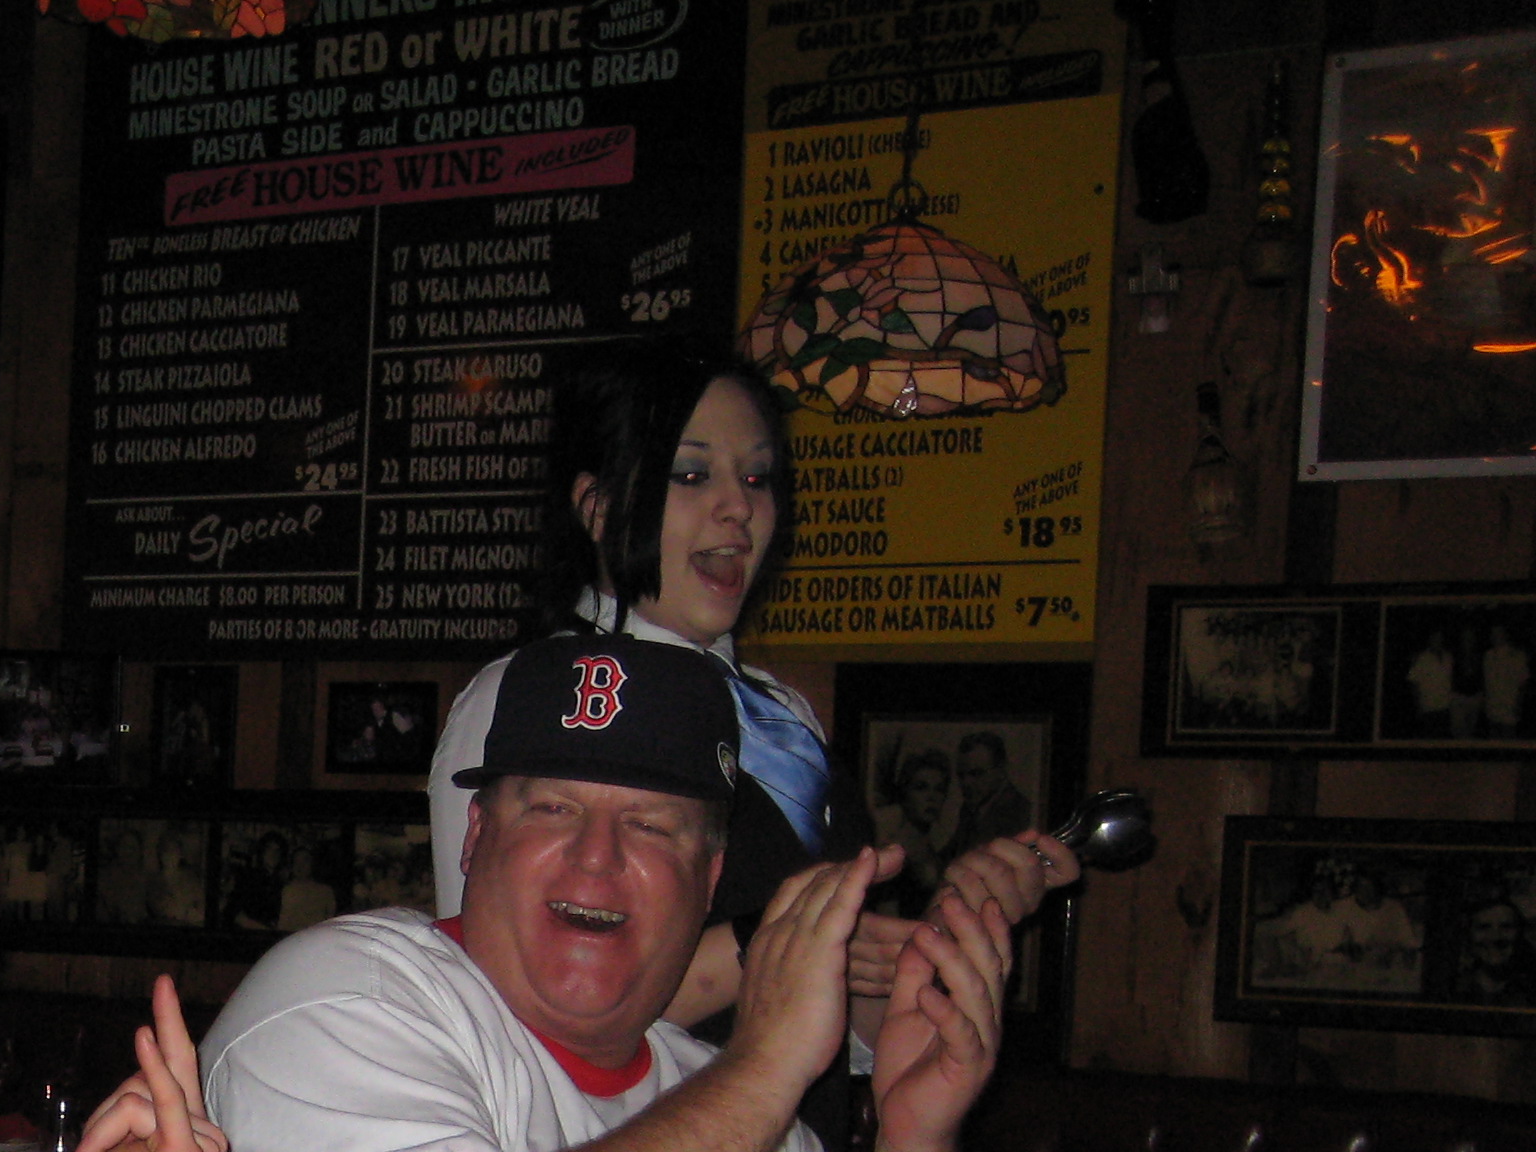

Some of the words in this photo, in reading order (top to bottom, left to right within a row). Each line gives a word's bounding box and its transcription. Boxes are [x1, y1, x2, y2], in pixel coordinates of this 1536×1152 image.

[598, 9, 664, 39] DINNER
[129, 55, 214, 104] HOUSE
[223, 43, 299, 92] WINE
[315, 30, 389, 80] RED
[400, 30, 443, 68] or
[453, 6, 584, 63] WHITE
[128, 95, 279, 140] MINESTRONE
[286, 86, 347, 121] SOUP
[352, 92, 375, 114] OR
[380, 74, 458, 112] SALAD
[486, 58, 583, 99] GARLIC
[590, 48, 679, 88] BREAD
[934, 66, 1012, 103] WINE
[191, 132, 267, 165] PASTA
[281, 121, 345, 155] SIDE
[357, 117, 398, 147] and
[414, 96, 584, 144] CAPPUCCINO
[769, 142, 777, 168] 1
[783, 133, 864, 167] RAVIOLI
[171, 168, 250, 222] FREE
[252, 158, 383, 207] HOUSE
[394, 146, 504, 192] WINE
[515, 128, 631, 176] INCLUDED
[764, 175, 774, 202] 2
[783, 168, 871, 200] LASAGNA
[494, 197, 553, 227] WHITE
[556, 194, 601, 222] VEAL
[764, 208, 773, 234] 3
[780, 200, 891, 232] MANICOTTI
[211, 224, 271, 252] BREAST
[288, 215, 362, 245] CHICKEN
[392, 246, 410, 272] 17
[418, 242, 463, 270] VEAL
[466, 235, 552, 267] PICCANTE
[760, 241, 771, 266] 4
[100, 272, 115, 296] 11
[121, 265, 189, 294] CHICKEN
[193, 262, 223, 288] RIO
[390, 281, 408, 306] 18
[417, 277, 461, 303] VEAL
[464, 271, 551, 300] MARSALA
[98, 303, 114, 328] 12
[120, 297, 188, 325] CHICKEN
[191, 289, 301, 320] PARMEGIANA
[388, 314, 407, 340] 19
[416, 310, 459, 338] VEAL
[464, 303, 585, 334] PARMEGIANA
[96, 335, 113, 360] 13
[119, 329, 187, 358] CHICKEN
[189, 322, 288, 352] CACCIATORE
[94, 370, 111, 395] 14
[116, 365, 165, 393] STEAK
[167, 361, 253, 390] PIZZAIOLA
[382, 360, 405, 386] 20
[413, 357, 465, 384] STEAK
[469, 352, 543, 380] CARUSO
[94, 406, 109, 431] 15
[116, 401, 187, 429] LINGUINI
[190, 397, 264, 424] CHOPPED
[268, 394, 322, 421] CLAMS
[385, 395, 403, 420] 21
[412, 392, 481, 419] SHRIMP
[91, 441, 107, 465] 16
[115, 437, 184, 464] CHICKEN
[183, 433, 257, 461] ALFREDO
[410, 421, 477, 448] BUTTER
[784, 432, 855, 461] AUSAGE
[861, 427, 983, 458] CACCIATORE
[380, 458, 400, 484] 22
[409, 456, 462, 482] FRESH
[465, 454, 504, 480] FISH
[507, 456, 531, 479] OF
[789, 465, 880, 494] EATBALLS
[1013, 478, 1037, 500] ANY
[1040, 467, 1064, 489] ONE
[1066, 461, 1083, 479] OF
[789, 500, 823, 527] EAT
[827, 496, 885, 524] SAUCE
[1015, 497, 1038, 517] THE
[1039, 480, 1079, 507] ABOVE
[134, 531, 182, 556] DAILY
[188, 503, 323, 570] Special
[378, 509, 398, 535] 23
[406, 508, 489, 535] BATTISTA
[492, 506, 543, 533] STYLE
[375, 547, 395, 572] 24
[403, 546, 450, 572] FILET
[451, 544, 529, 571] MIGNON
[783, 530, 889, 559] OMODORO
[90, 587, 157, 608] MINIMUM
[158, 586, 210, 607] CHARGE
[219, 585, 258, 606] $8.00
[264, 585, 289, 606] PER
[292, 584, 346, 605] PERSON
[375, 585, 394, 609] 25
[402, 583, 441, 609] NEW
[444, 583, 498, 608] YORK
[806, 575, 883, 603] ORDERS
[887, 574, 914, 601] OF
[918, 572, 1002, 600] ITALIAN
[208, 619, 261, 640] PARTIES
[264, 619, 282, 640] OF
[284, 619, 292, 639] 8
[319, 618, 360, 640] MORE
[370, 618, 440, 640] GRATUITY
[443, 617, 519, 640] INCLUDED
[761, 605, 843, 634] SAUSAGE
[848, 606, 877, 632] OR
[881, 603, 996, 632] MEATBALLS
[560, 654, 630, 731] B
